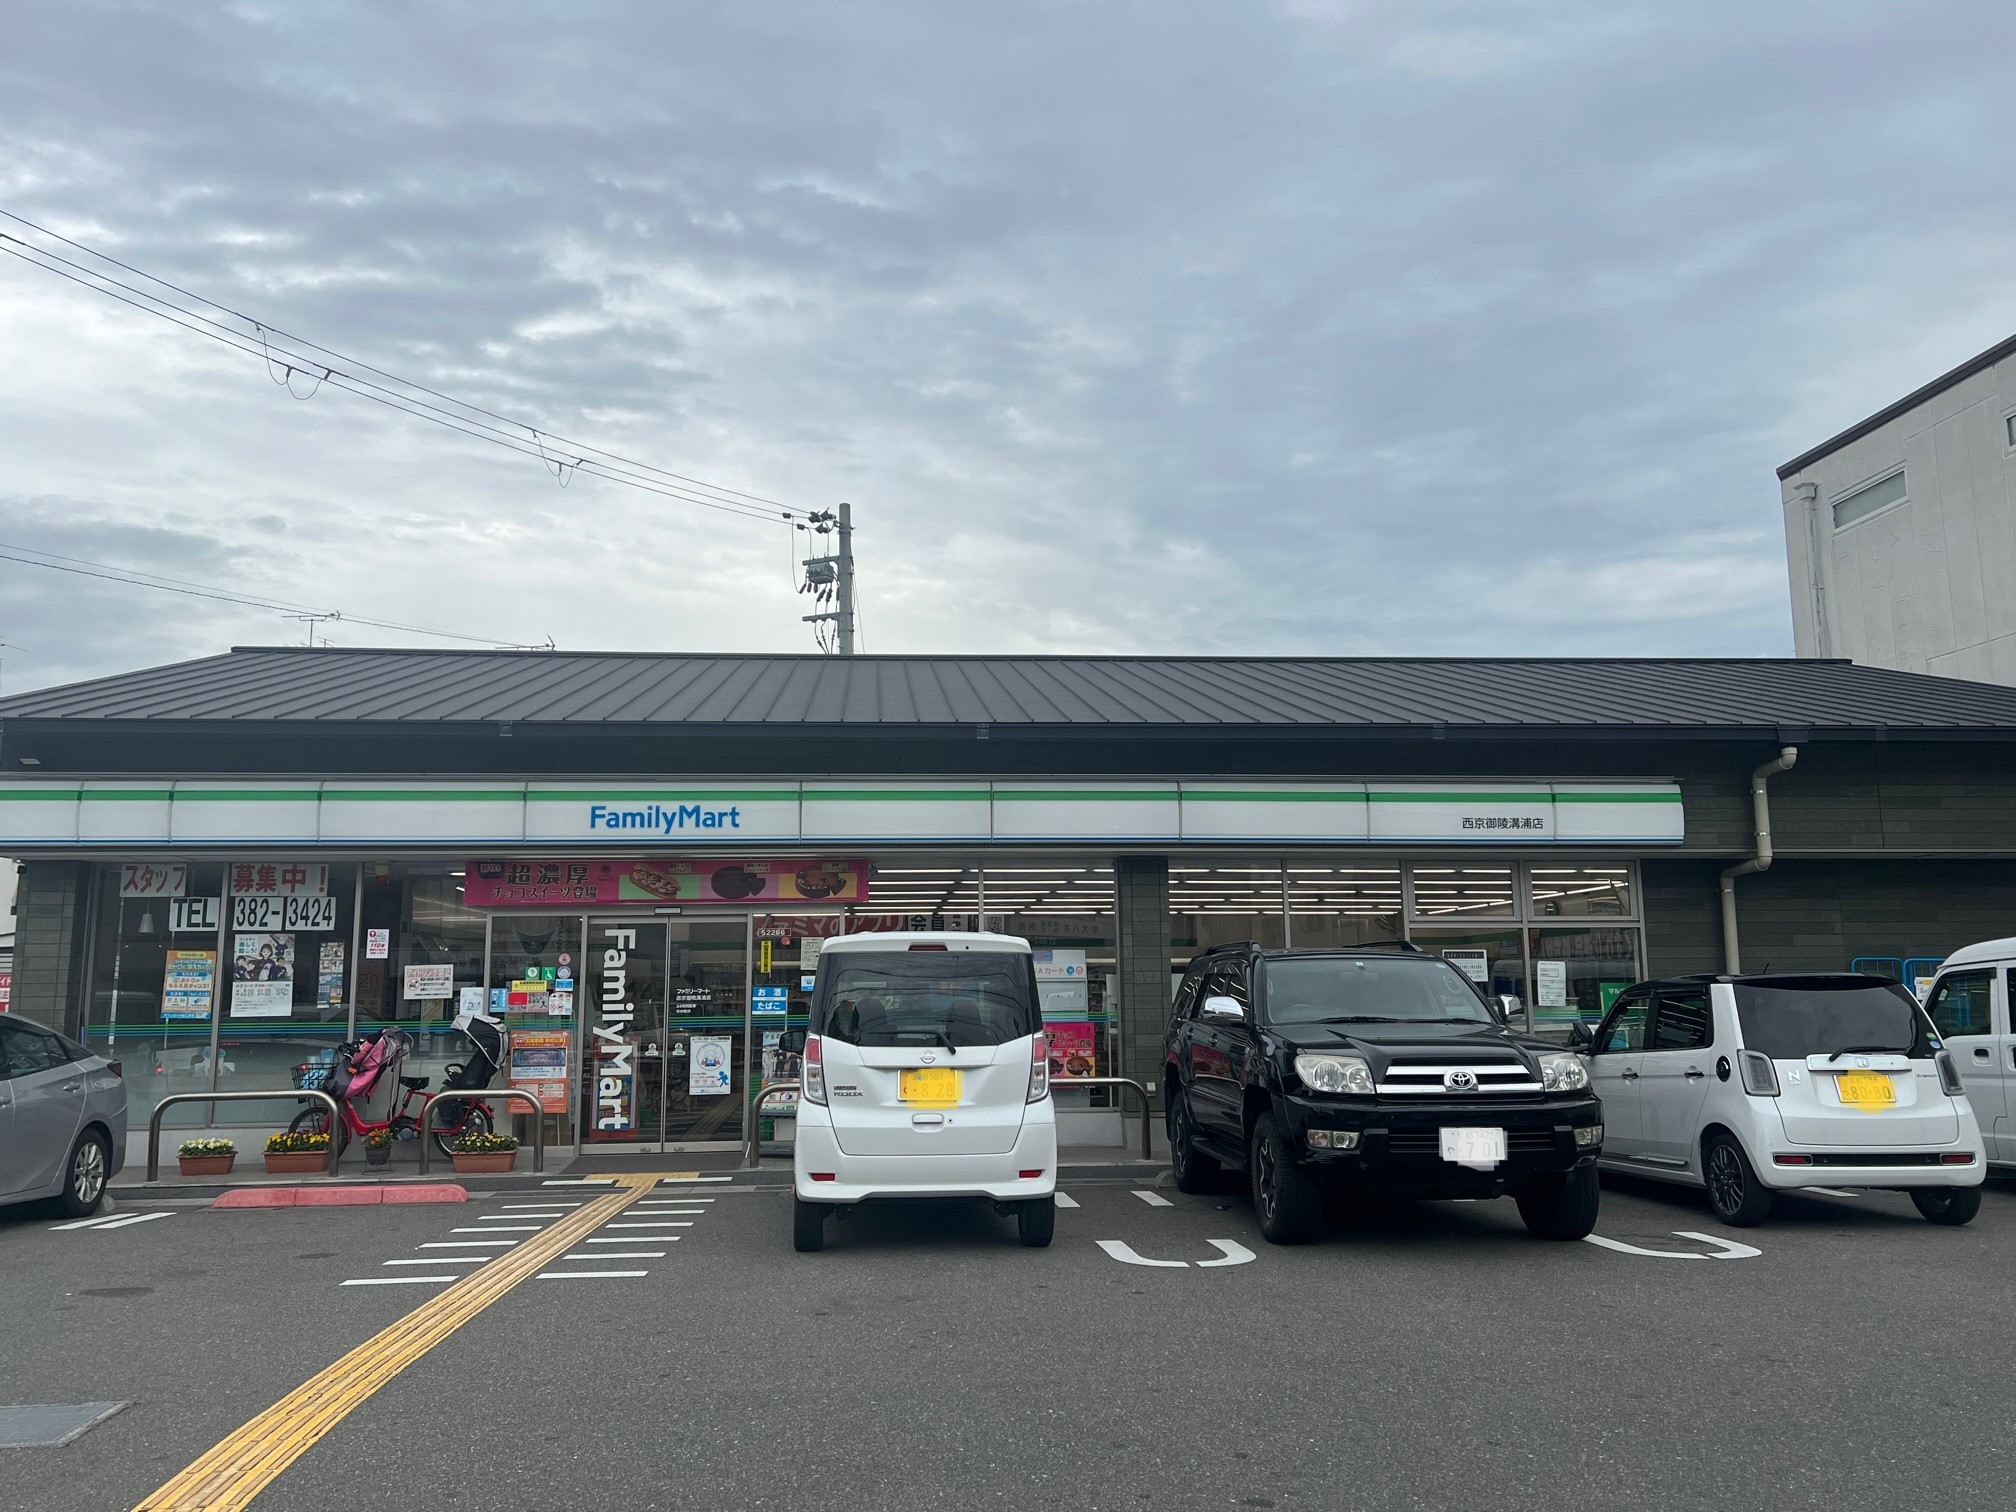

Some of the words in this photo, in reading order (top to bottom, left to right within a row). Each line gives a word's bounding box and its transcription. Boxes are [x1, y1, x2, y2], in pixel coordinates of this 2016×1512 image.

[590, 804, 740, 835] FamilyMart
[1462, 817, 1544, 829] 西京御陵溝浦店
[123, 864, 185, 893] スタッフ
[507, 863, 590, 885] 超濃厚
[492, 886, 597, 899] チョコスイーツ登場
[172, 898, 216, 928] TEL
[236, 897, 333, 927] 382-3424
[757, 1002, 781, 1010] たばこ
[592, 928, 636, 1130] FamilyMart
[1788, 1070, 1801, 1081] N
